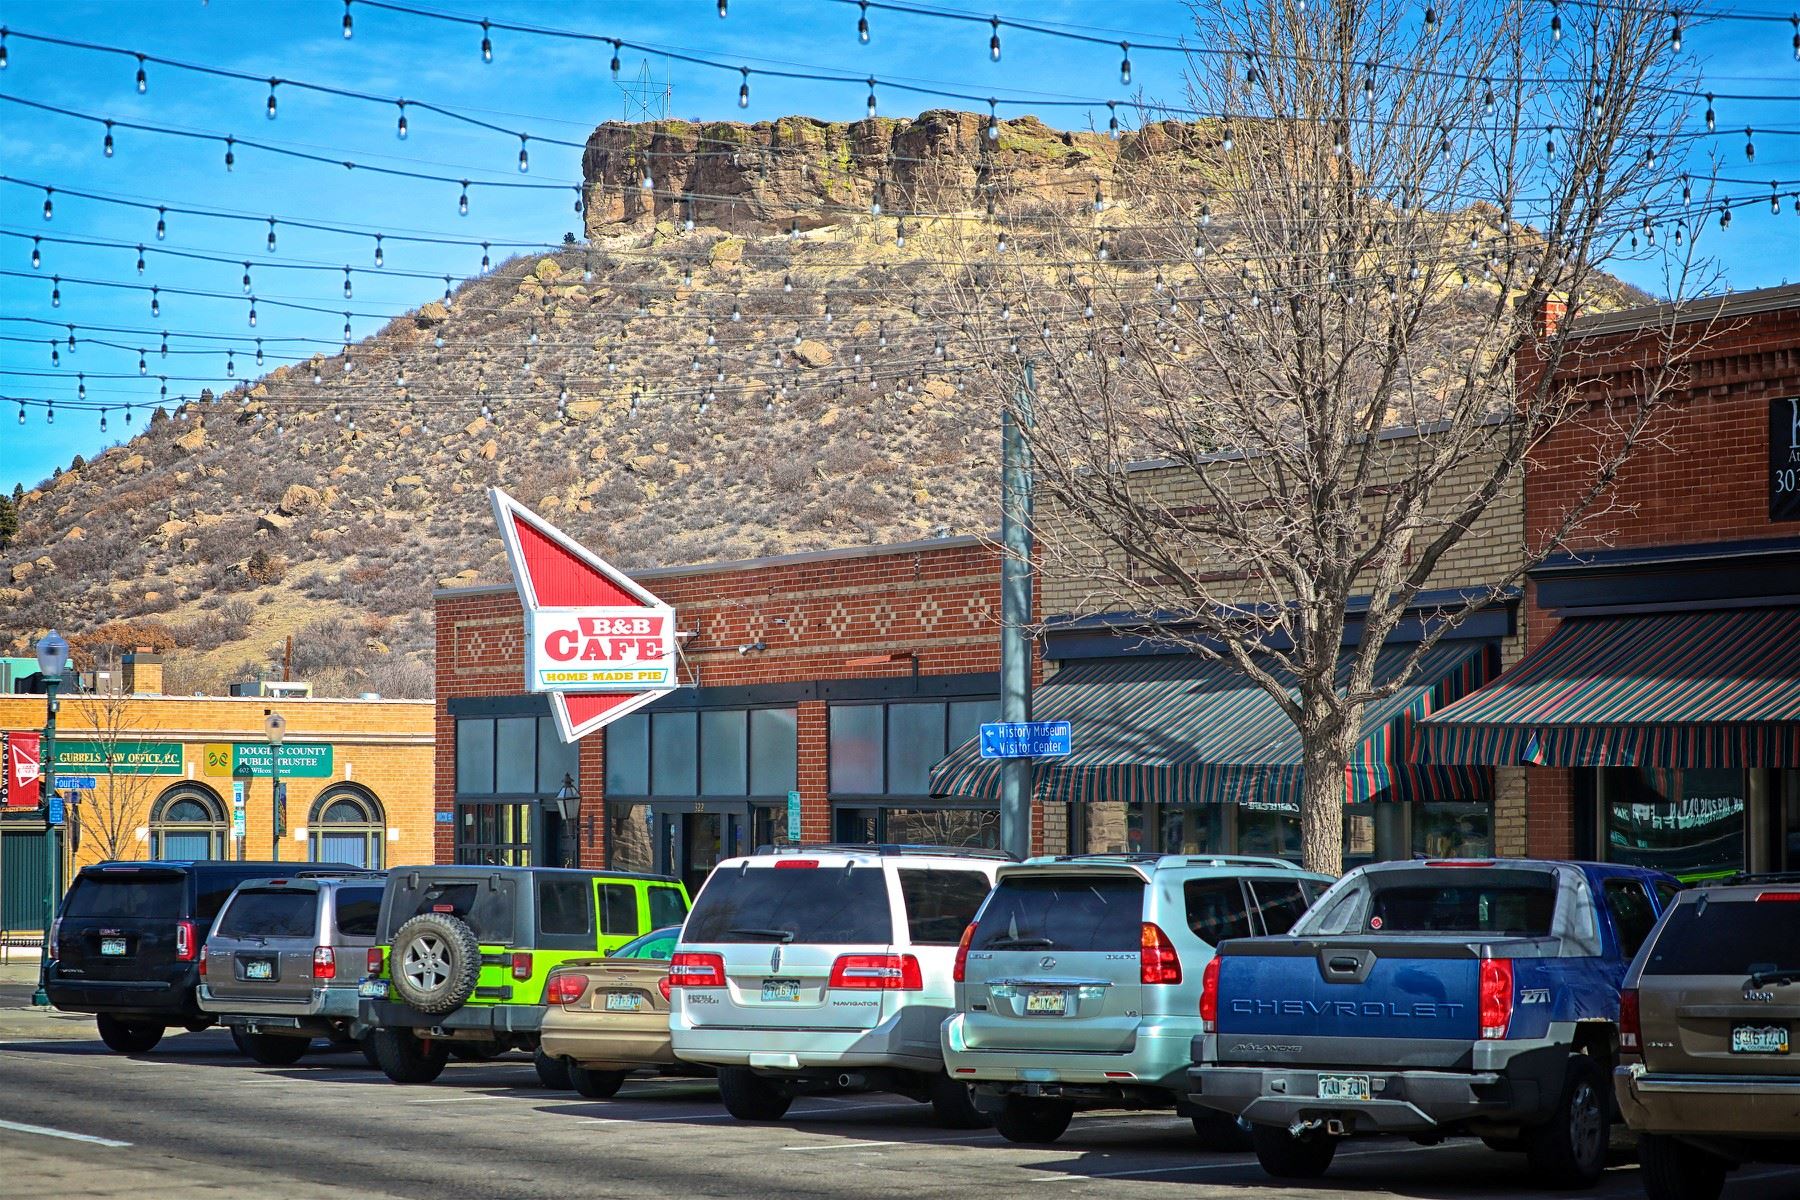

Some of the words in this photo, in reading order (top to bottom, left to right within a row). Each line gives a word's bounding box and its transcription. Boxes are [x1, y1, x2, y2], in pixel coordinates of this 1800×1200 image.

[592, 619, 651, 635] B&B
[544, 629, 663, 662] CAFE
[546, 672, 588, 681] HOME
[592, 672, 634, 681] MADE
[637, 671, 662, 680] PIE
[998, 725, 1031, 740] History
[1033, 725, 1067, 737] Museum
[240, 747, 284, 756] DOUGLS
[287, 747, 327, 756] COUNTY
[999, 741, 1031, 754] Visitor
[1033, 741, 1062, 753] Center
[60, 752, 102, 763] GUBBELS
[239, 757, 273, 767] PUBLIC
[1231, 999, 1464, 1018] CHEVROLET
